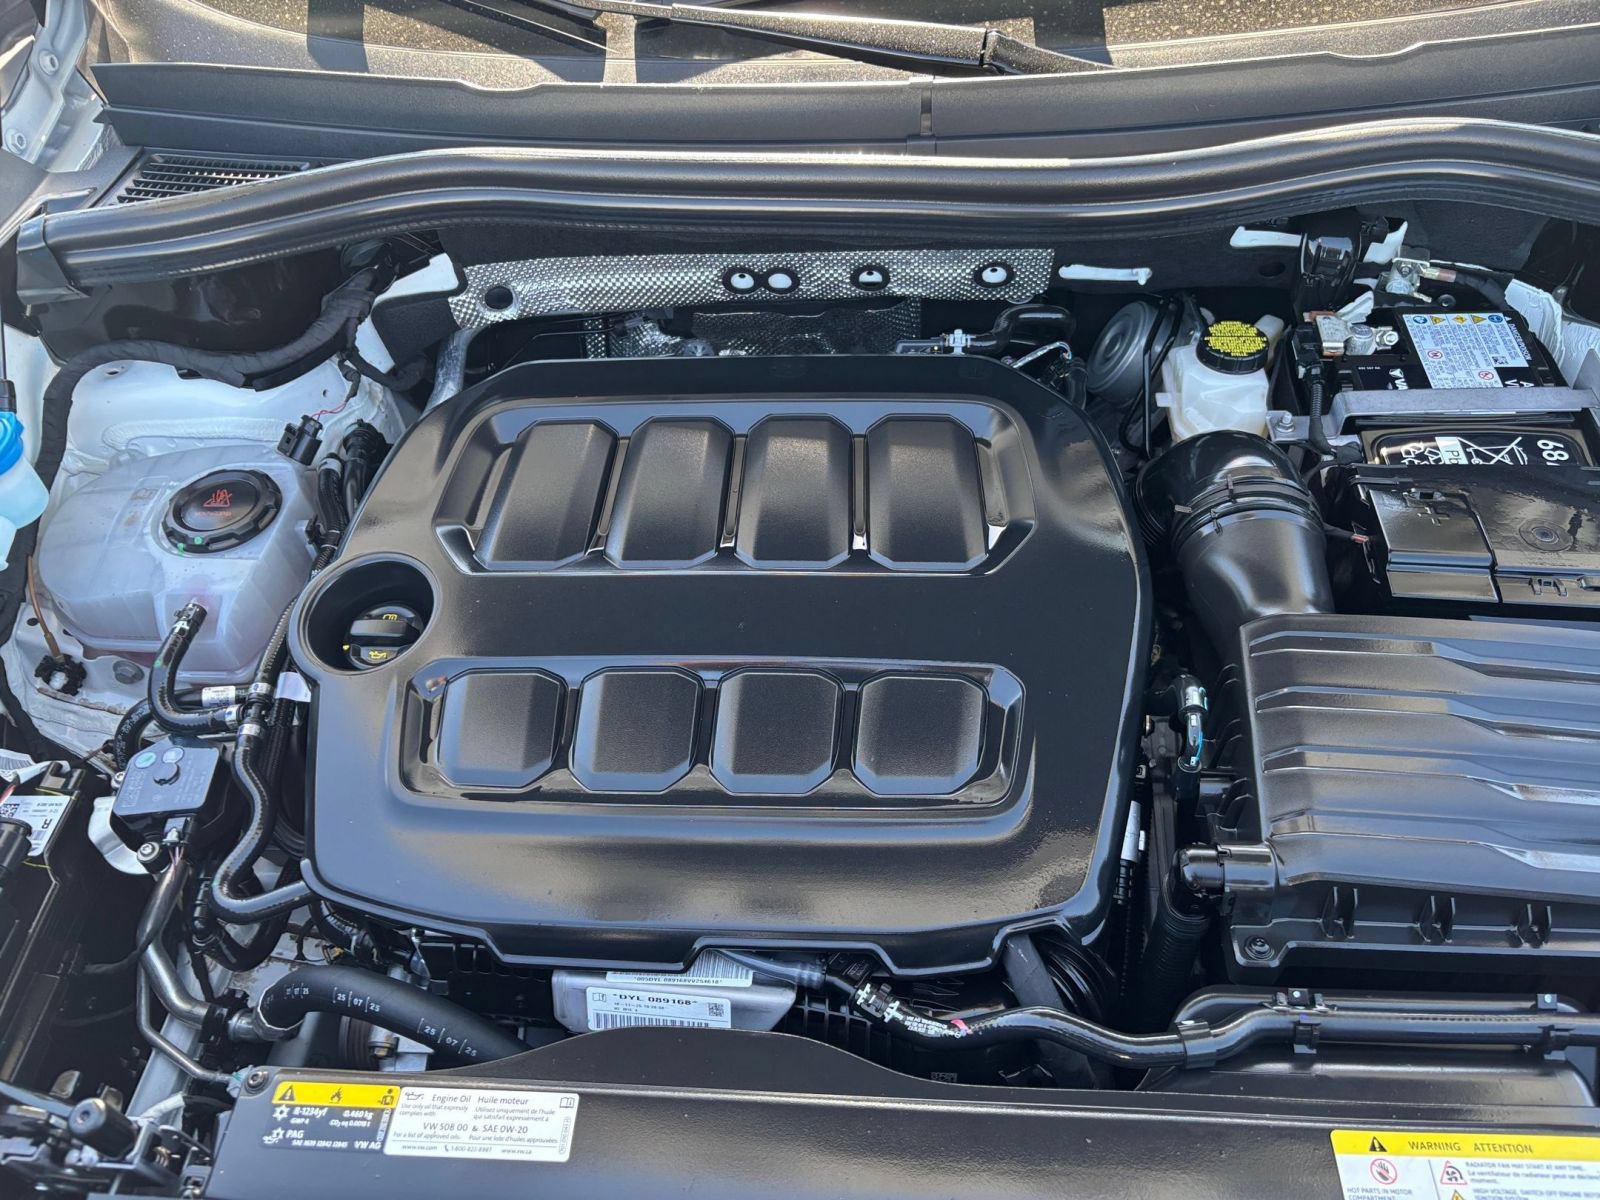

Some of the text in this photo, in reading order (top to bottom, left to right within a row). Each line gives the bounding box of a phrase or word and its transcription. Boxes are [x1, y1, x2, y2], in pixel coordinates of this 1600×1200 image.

[337, 993, 380, 1012] 25 07 25
[424, 1026, 477, 1056] 25 07 25
[432, 1094, 458, 1104] Engine
[364, 1110, 374, 1120] kg
[286, 1130, 304, 1138] PAG
[482, 1124, 498, 1132] SAE
[500, 1125, 528, 1134] 0W-20
[354, 1141, 368, 1149] VW
[1408, 1141, 1534, 1154] WARNING ATTENTION
